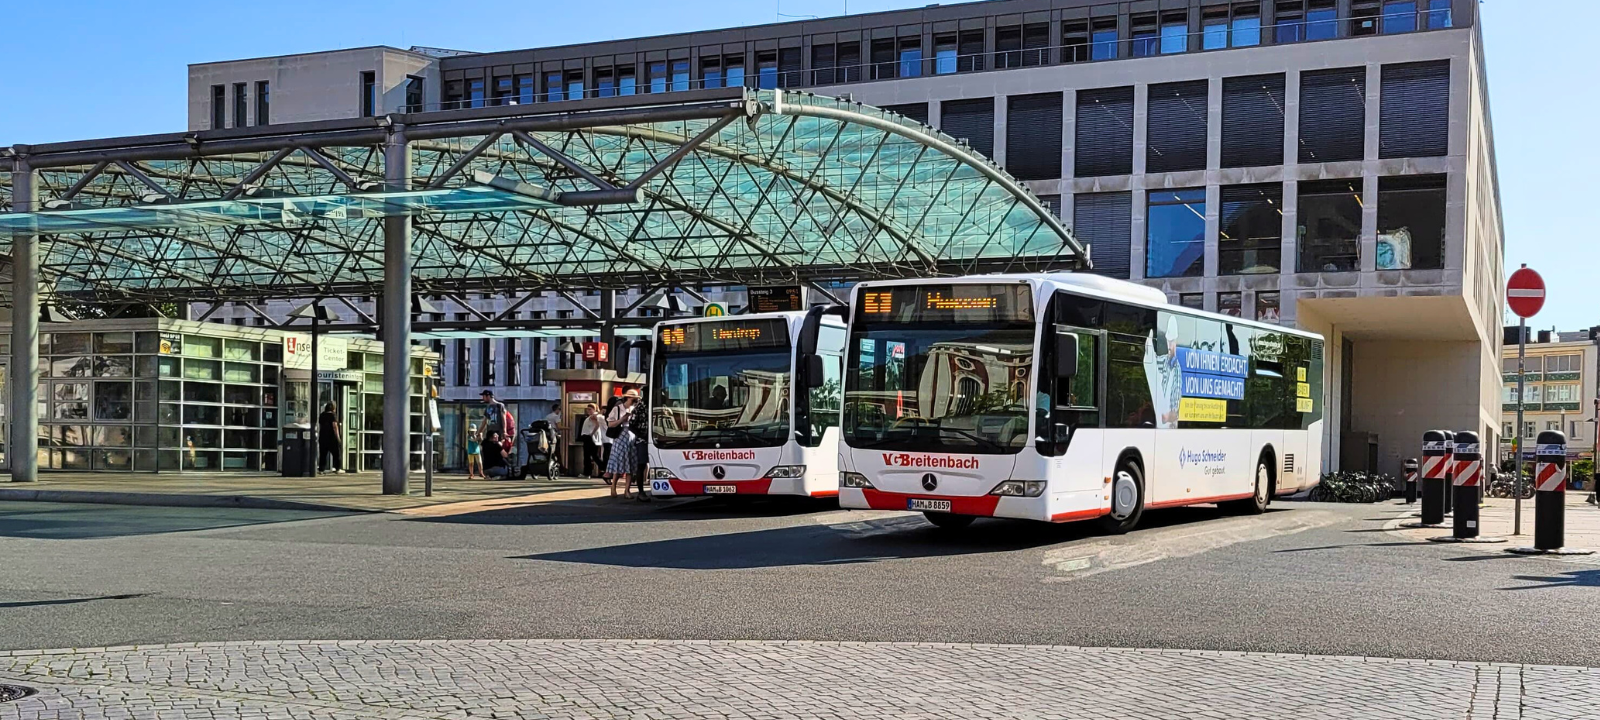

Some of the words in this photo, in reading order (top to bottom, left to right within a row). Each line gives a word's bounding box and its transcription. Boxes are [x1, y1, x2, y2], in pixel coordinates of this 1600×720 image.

[324, 347, 345, 355] Ticket-
[1185, 351, 1199, 369] VON
[1200, 353, 1219, 371] IHNEN
[1220, 356, 1248, 377] ERDACHT,
[1185, 376, 1199, 394] VON
[1200, 377, 1213, 395] UNS
[1187, 449, 1201, 465] Hugo
[1202, 449, 1226, 462] Schneider
[933, 501, 950, 510] 8859
